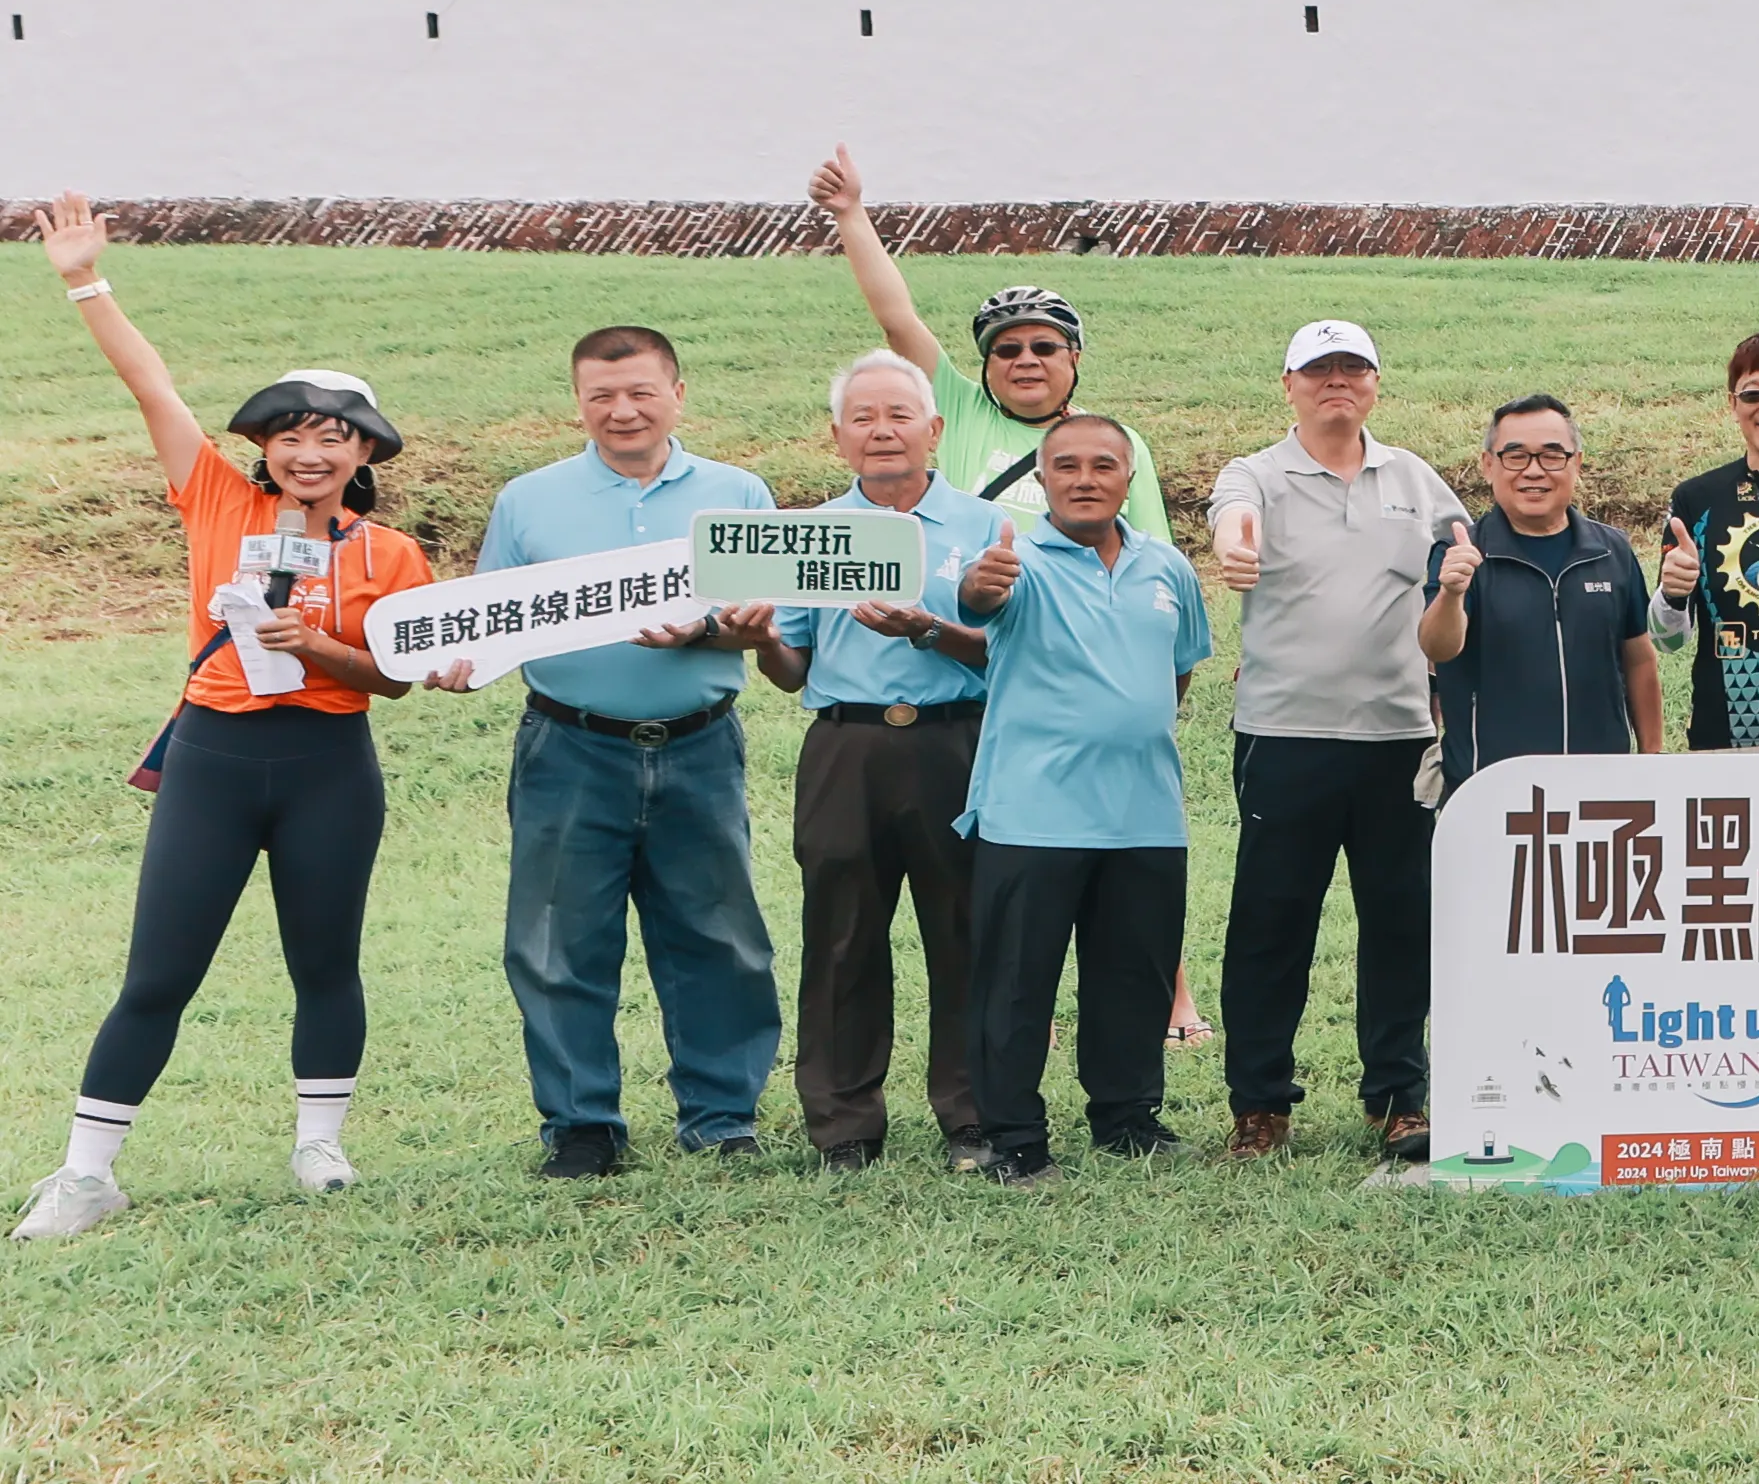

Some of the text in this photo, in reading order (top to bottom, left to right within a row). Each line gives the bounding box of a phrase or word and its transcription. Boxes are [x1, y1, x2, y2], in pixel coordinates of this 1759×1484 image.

[709, 523, 853, 556] 好吃好玩
[392, 564, 691, 656] 聽說路線超陡的
[1603, 977, 1736, 1049] Light
[1616, 1167, 1648, 1179] 2024
[1655, 1166, 1687, 1181] Light
[1690, 1166, 1709, 1180] Up
